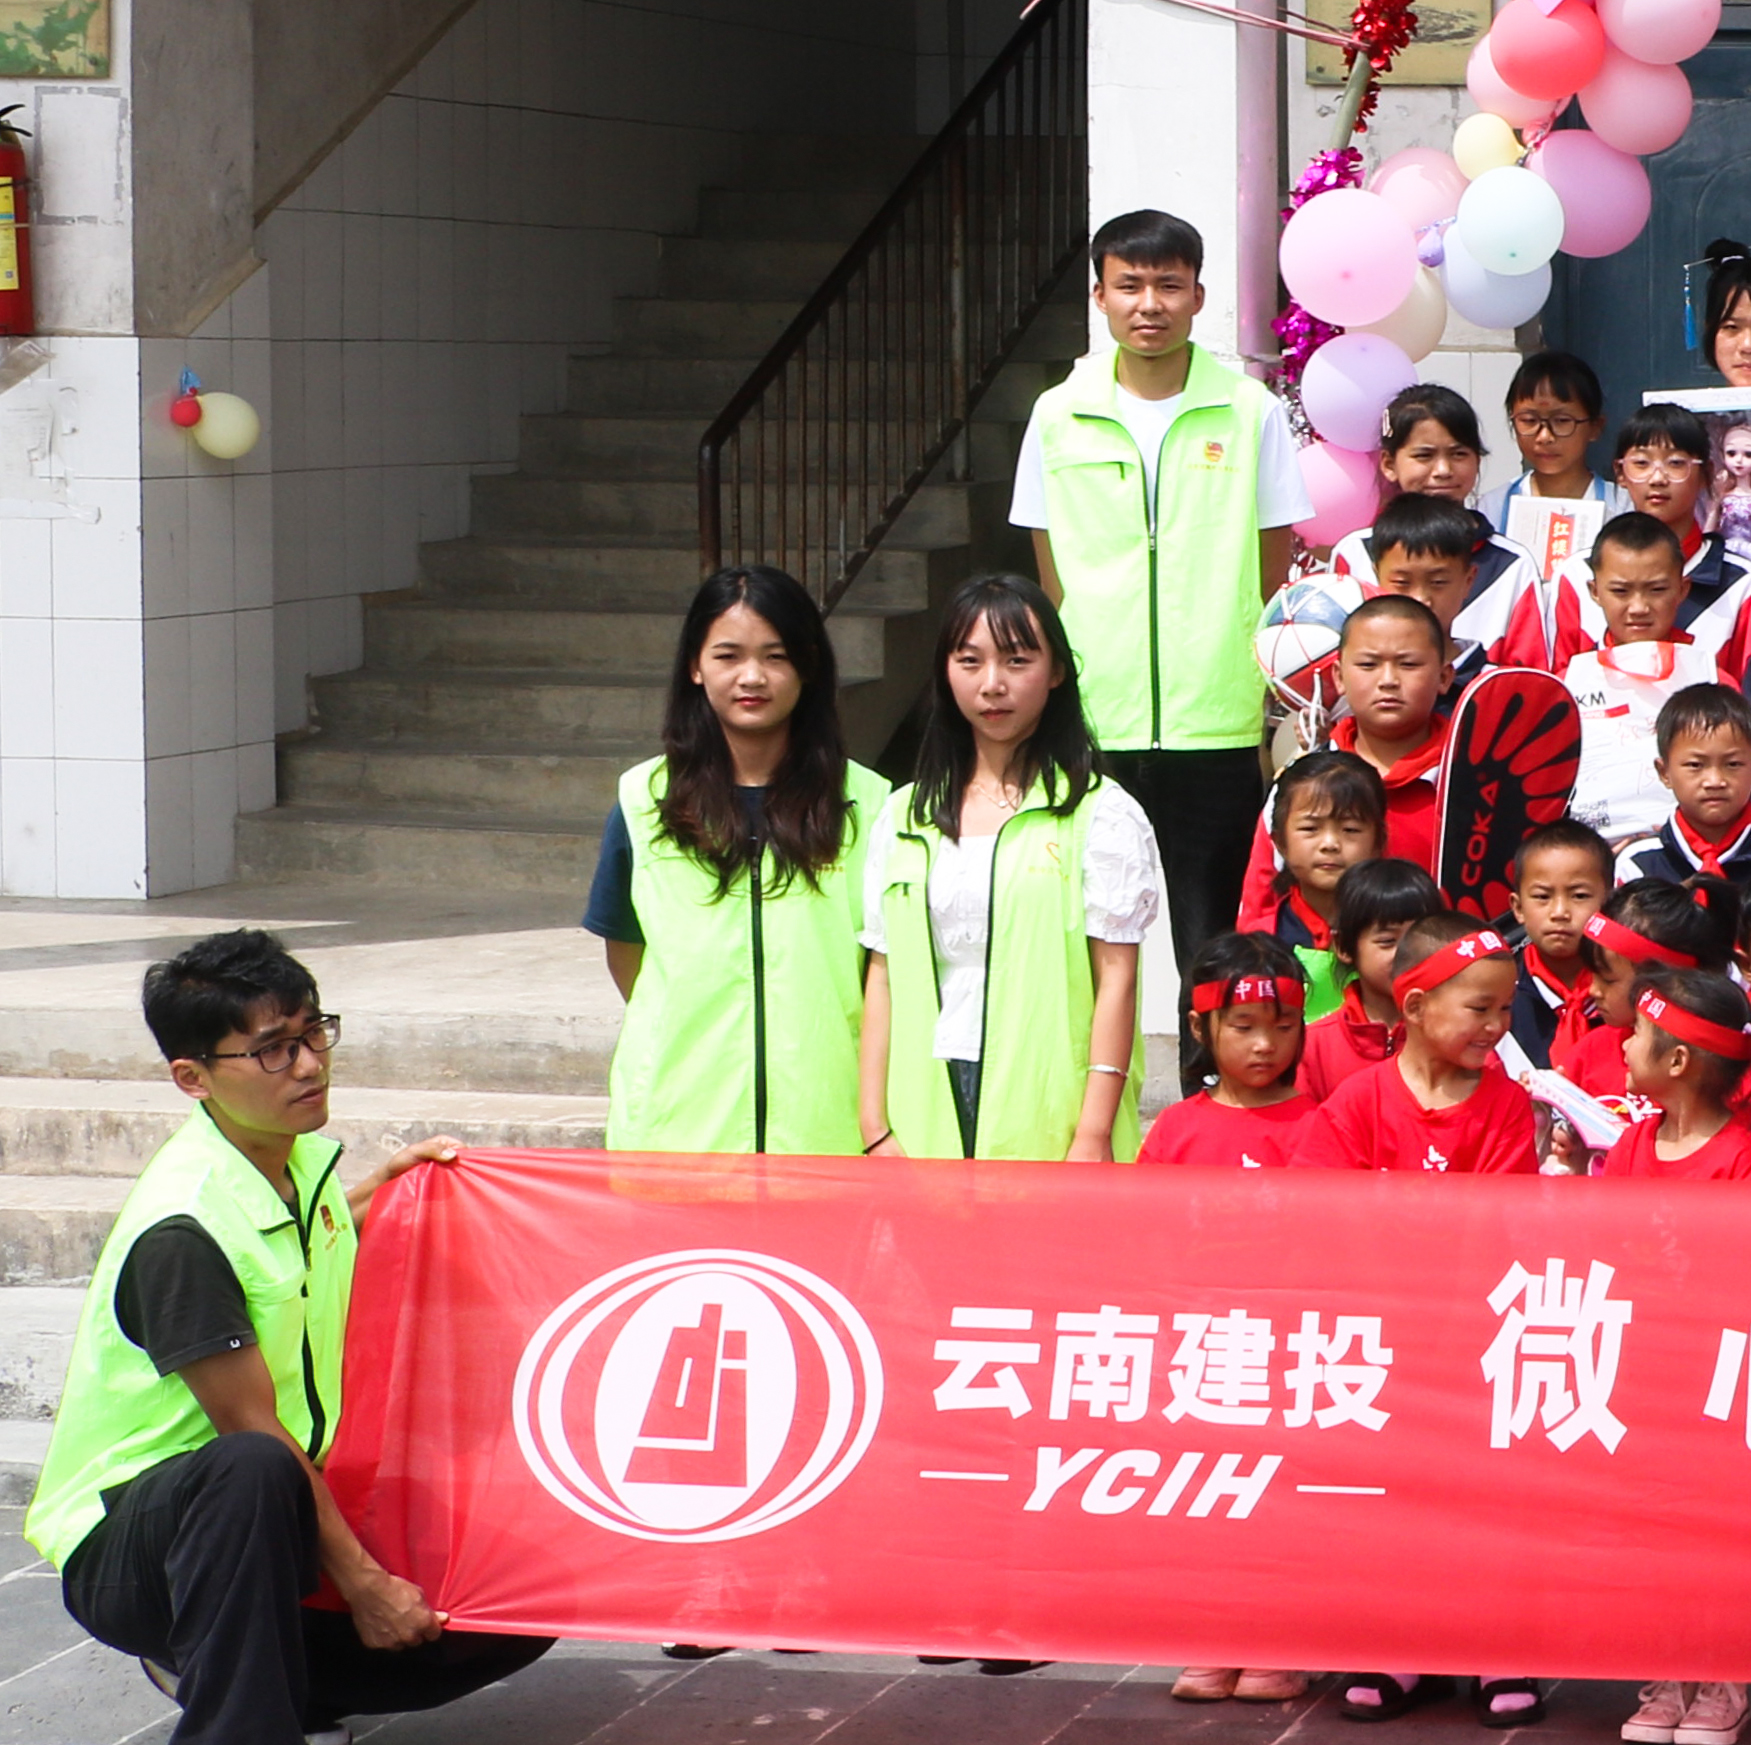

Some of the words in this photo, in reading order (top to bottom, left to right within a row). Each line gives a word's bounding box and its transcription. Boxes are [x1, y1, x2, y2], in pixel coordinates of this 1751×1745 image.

[1461, 779, 1500, 886] COKA
[1587, 914, 1607, 937] 国
[1456, 930, 1503, 958] 中国
[1234, 979, 1276, 1001] 中国
[1638, 988, 1666, 1019] 中国
[930, 1304, 1393, 1432] 云南建投
[1021, 1446, 1278, 1520] YCIH
